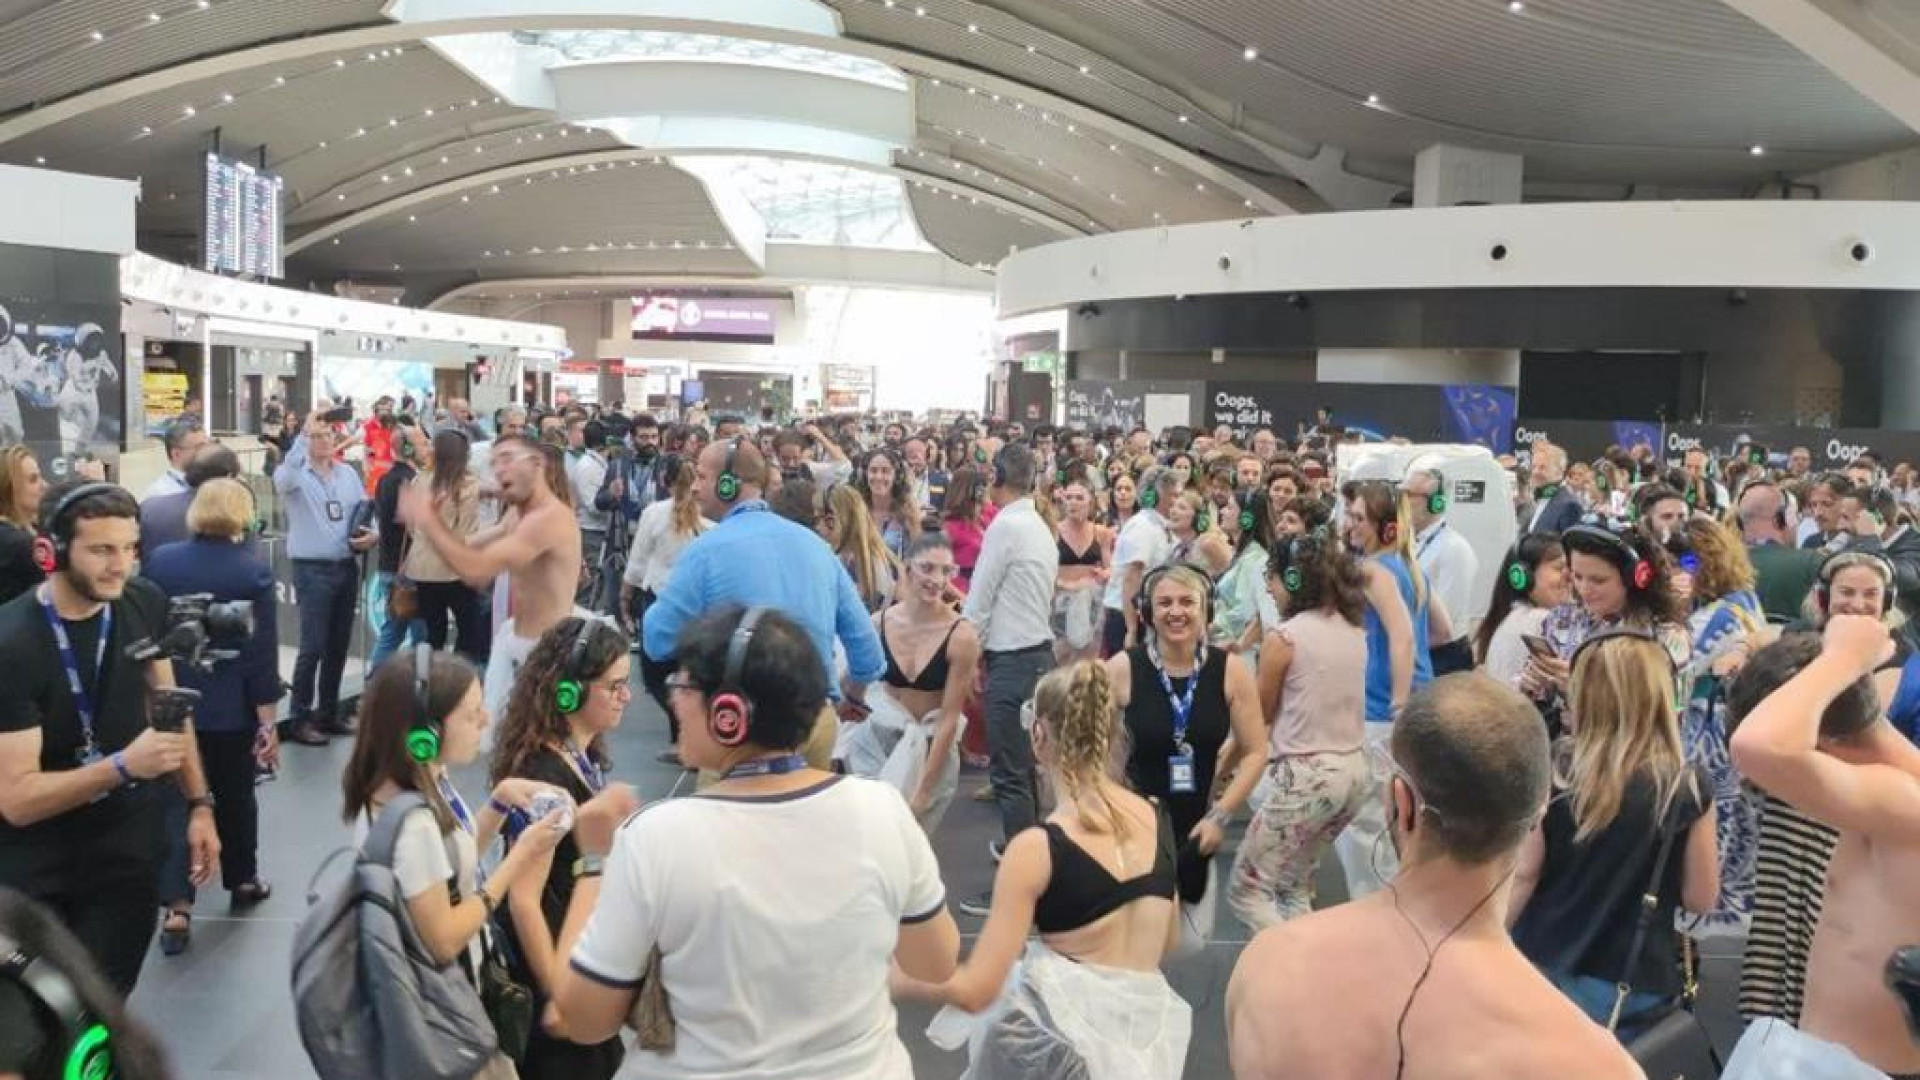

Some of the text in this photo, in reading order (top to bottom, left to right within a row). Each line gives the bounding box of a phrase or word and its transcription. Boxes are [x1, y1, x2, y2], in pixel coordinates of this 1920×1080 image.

[1214, 409, 1272, 425] we did it
